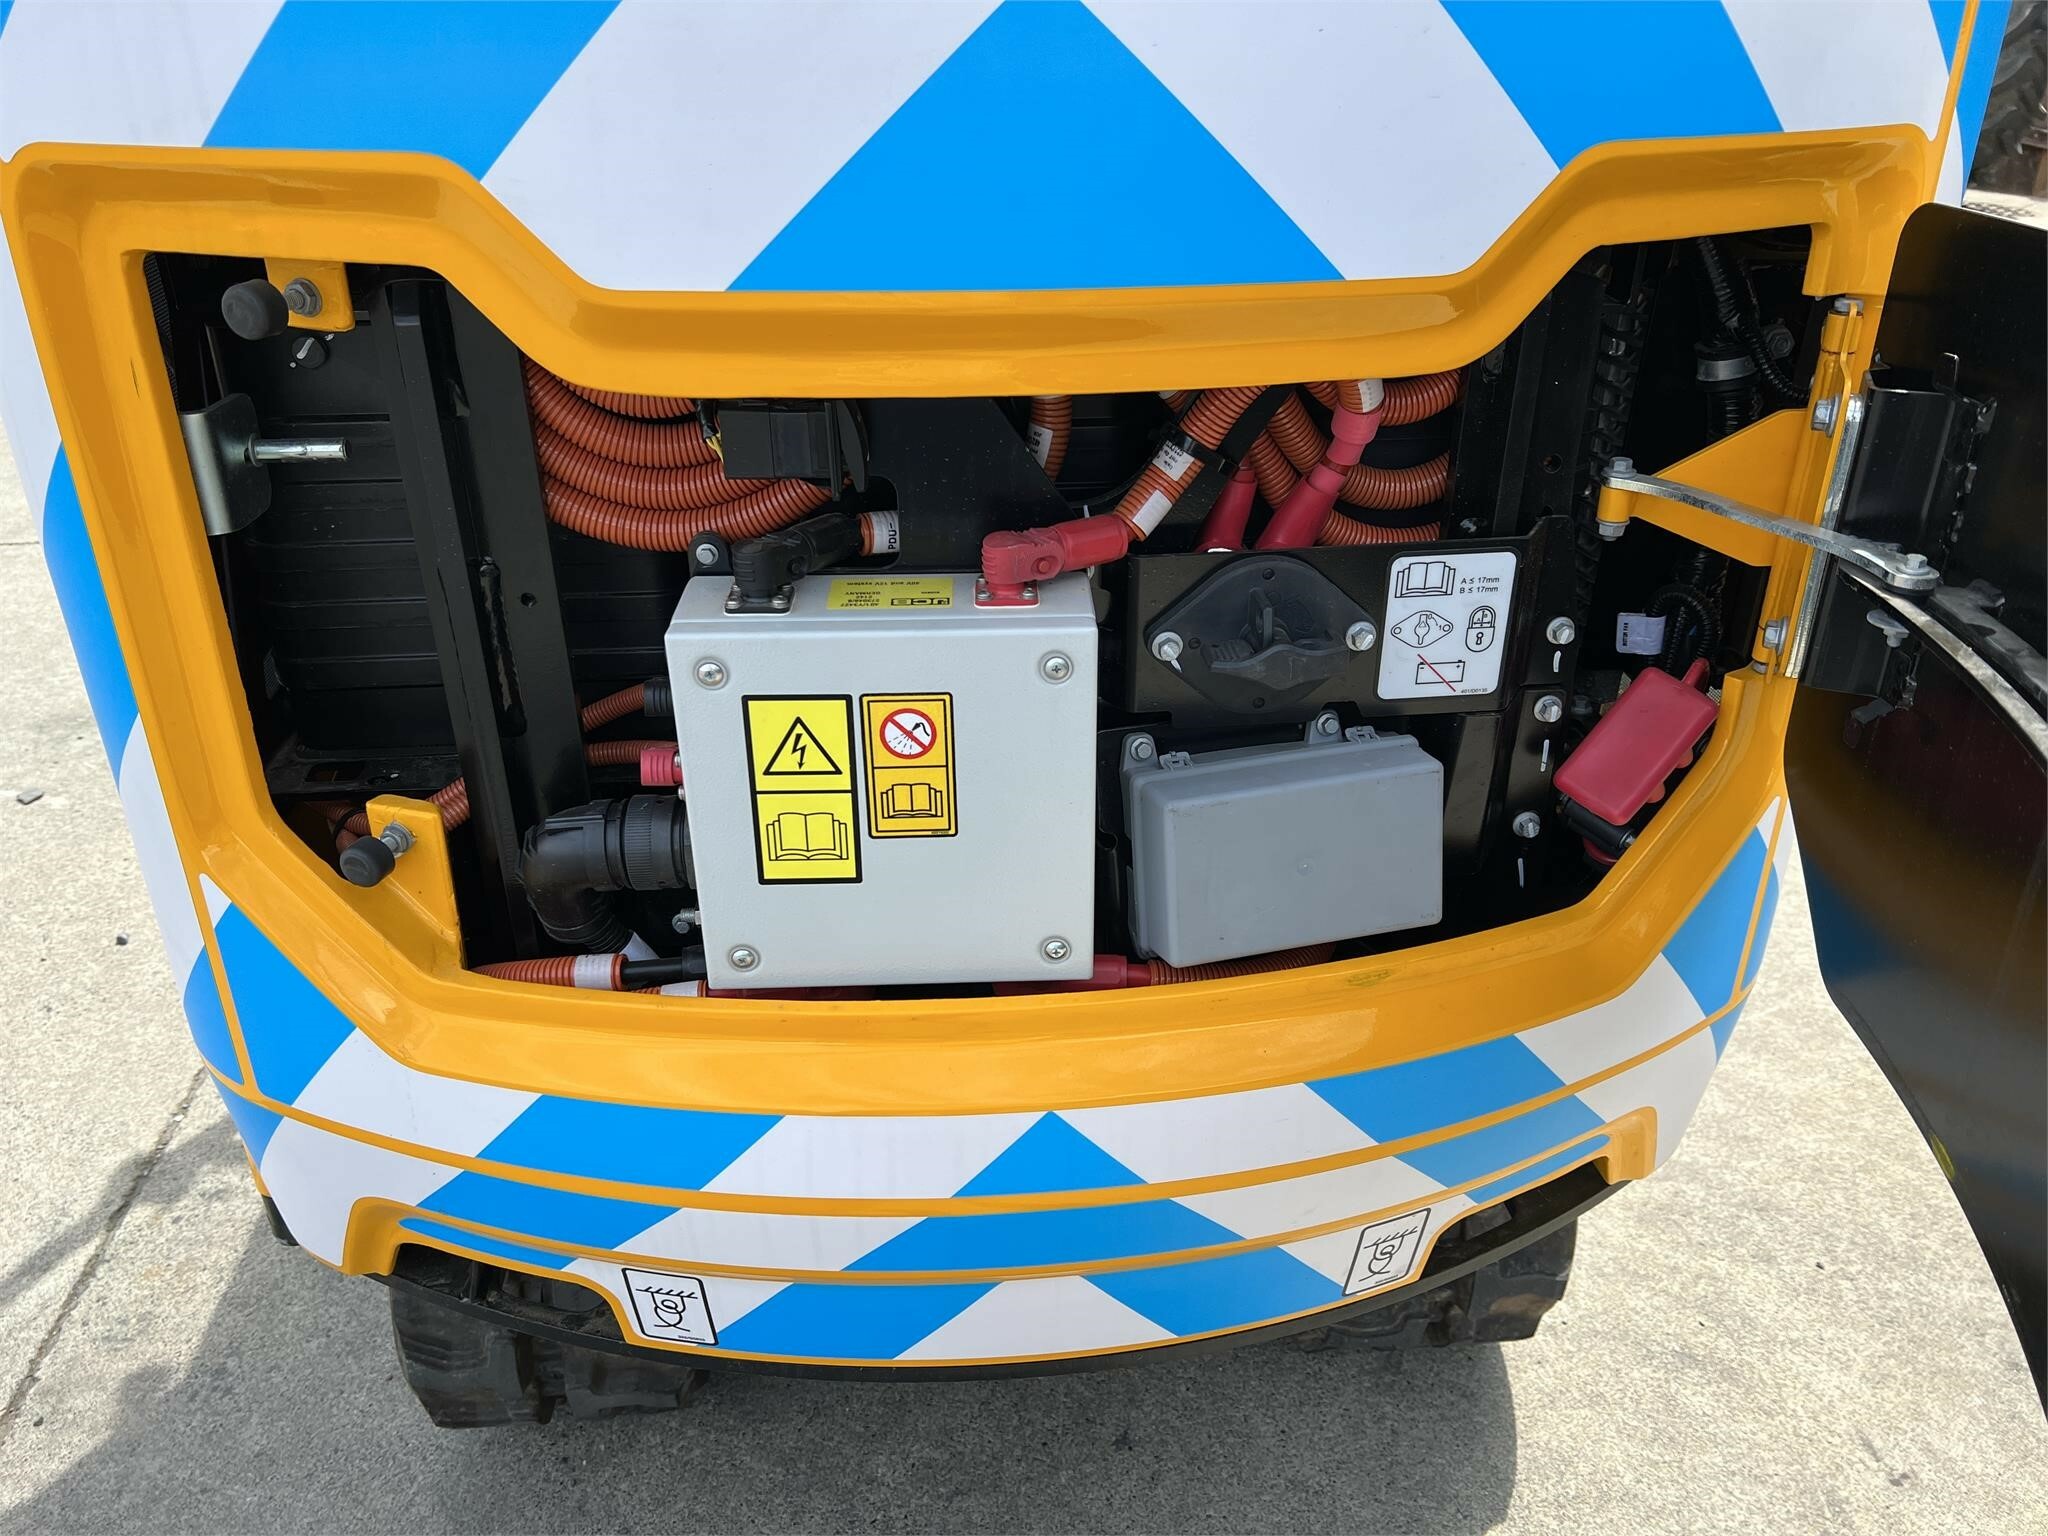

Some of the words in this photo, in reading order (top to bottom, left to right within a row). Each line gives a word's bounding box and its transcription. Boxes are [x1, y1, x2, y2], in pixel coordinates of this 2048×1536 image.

[1460, 577, 1468, 585] A
[1477, 576, 1500, 584] 17mm
[1459, 586, 1466, 594] B
[1476, 585, 1499, 593] 17mm
[890, 597, 950, 606] JCB
